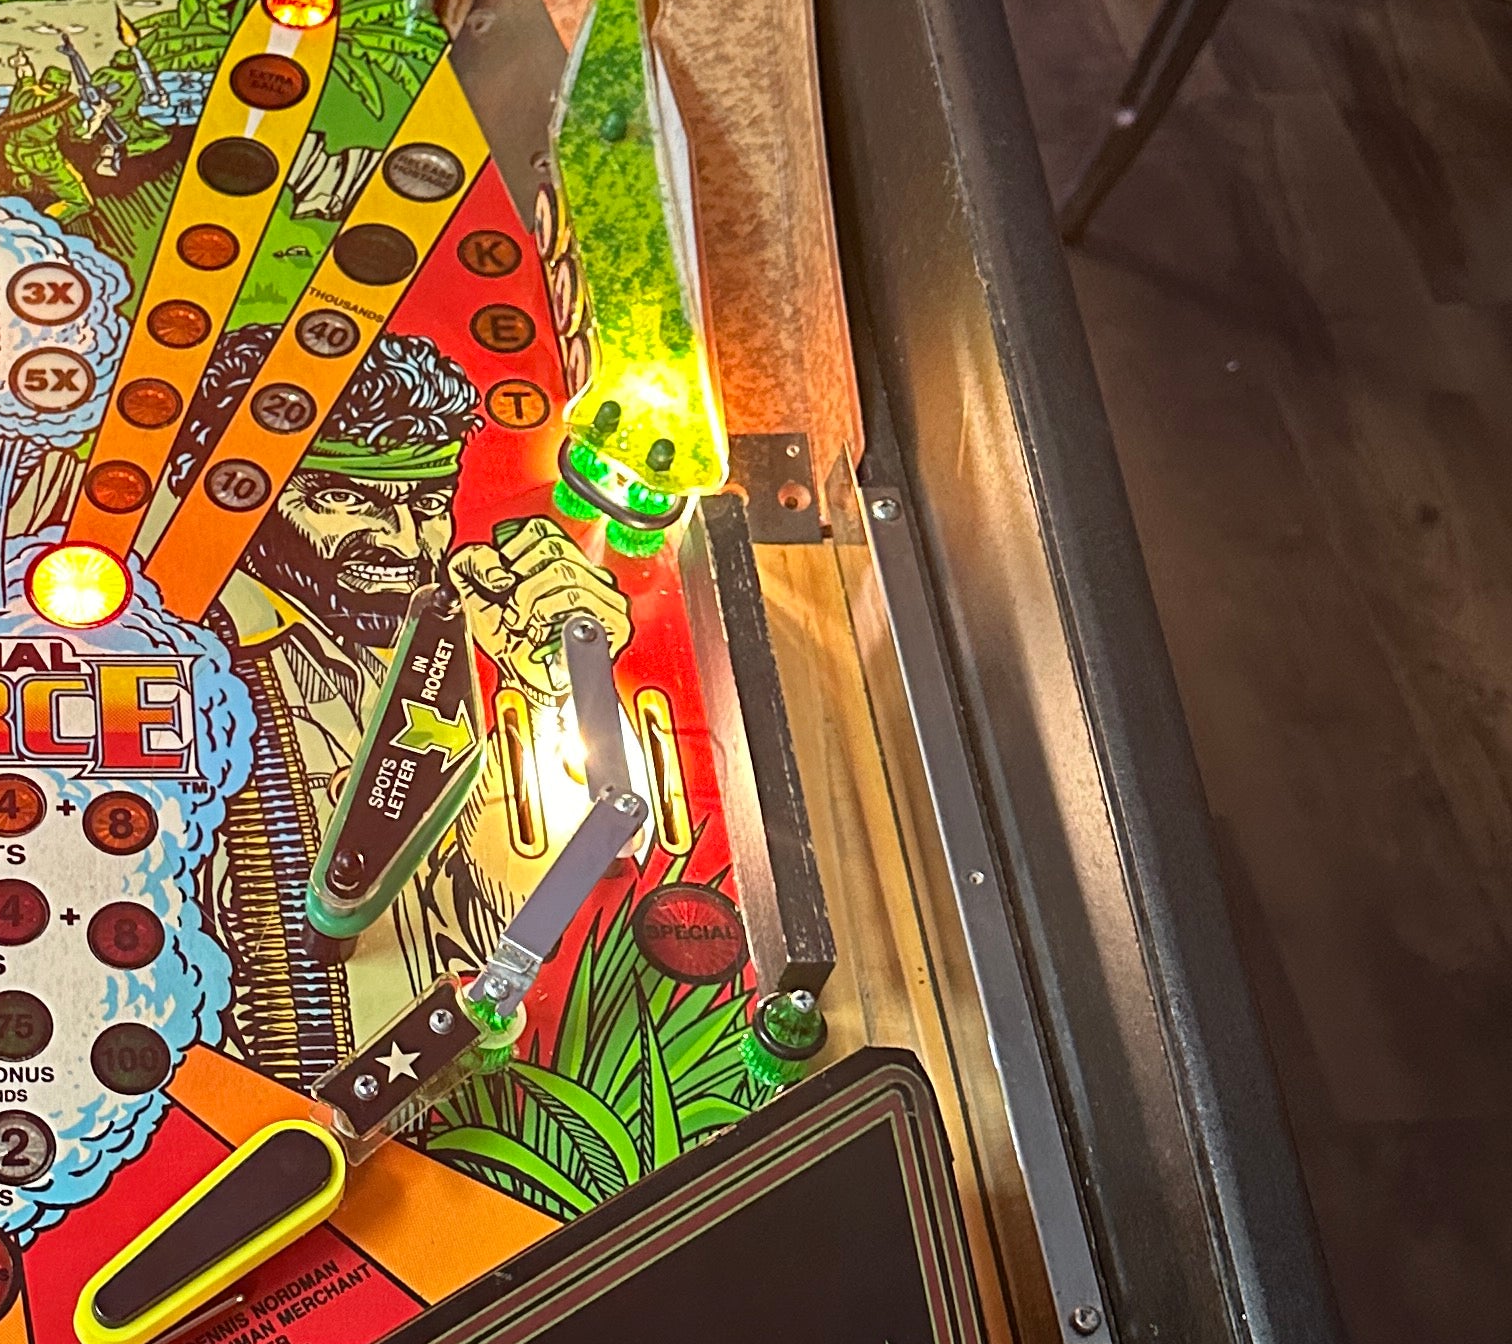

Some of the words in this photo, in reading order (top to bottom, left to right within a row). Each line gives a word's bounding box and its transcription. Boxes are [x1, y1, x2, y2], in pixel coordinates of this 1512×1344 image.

[22, 281, 75, 305] 3X
[308, 287, 386, 324] THOUSANDS
[306, 321, 348, 348] 40
[476, 242, 501, 265] K
[490, 315, 519, 343] E
[506, 391, 531, 419] T
[23, 368, 81, 392] 5X
[264, 394, 305, 422] 20
[221, 471, 255, 498] 10
[411, 654, 431, 674] IN
[419, 638, 457, 702] ROCKET
[368, 757, 397, 810] SPOTS
[384, 759, 418, 820] LETTER
[107, 810, 133, 839] 8
[112, 918, 138, 950] 8
[645, 924, 740, 941] SPECIAL
[1, 1128, 30, 1167] 2
[251, 1260, 341, 1317] NORDMAN
[279, 1262, 373, 1328] MERCHANT
